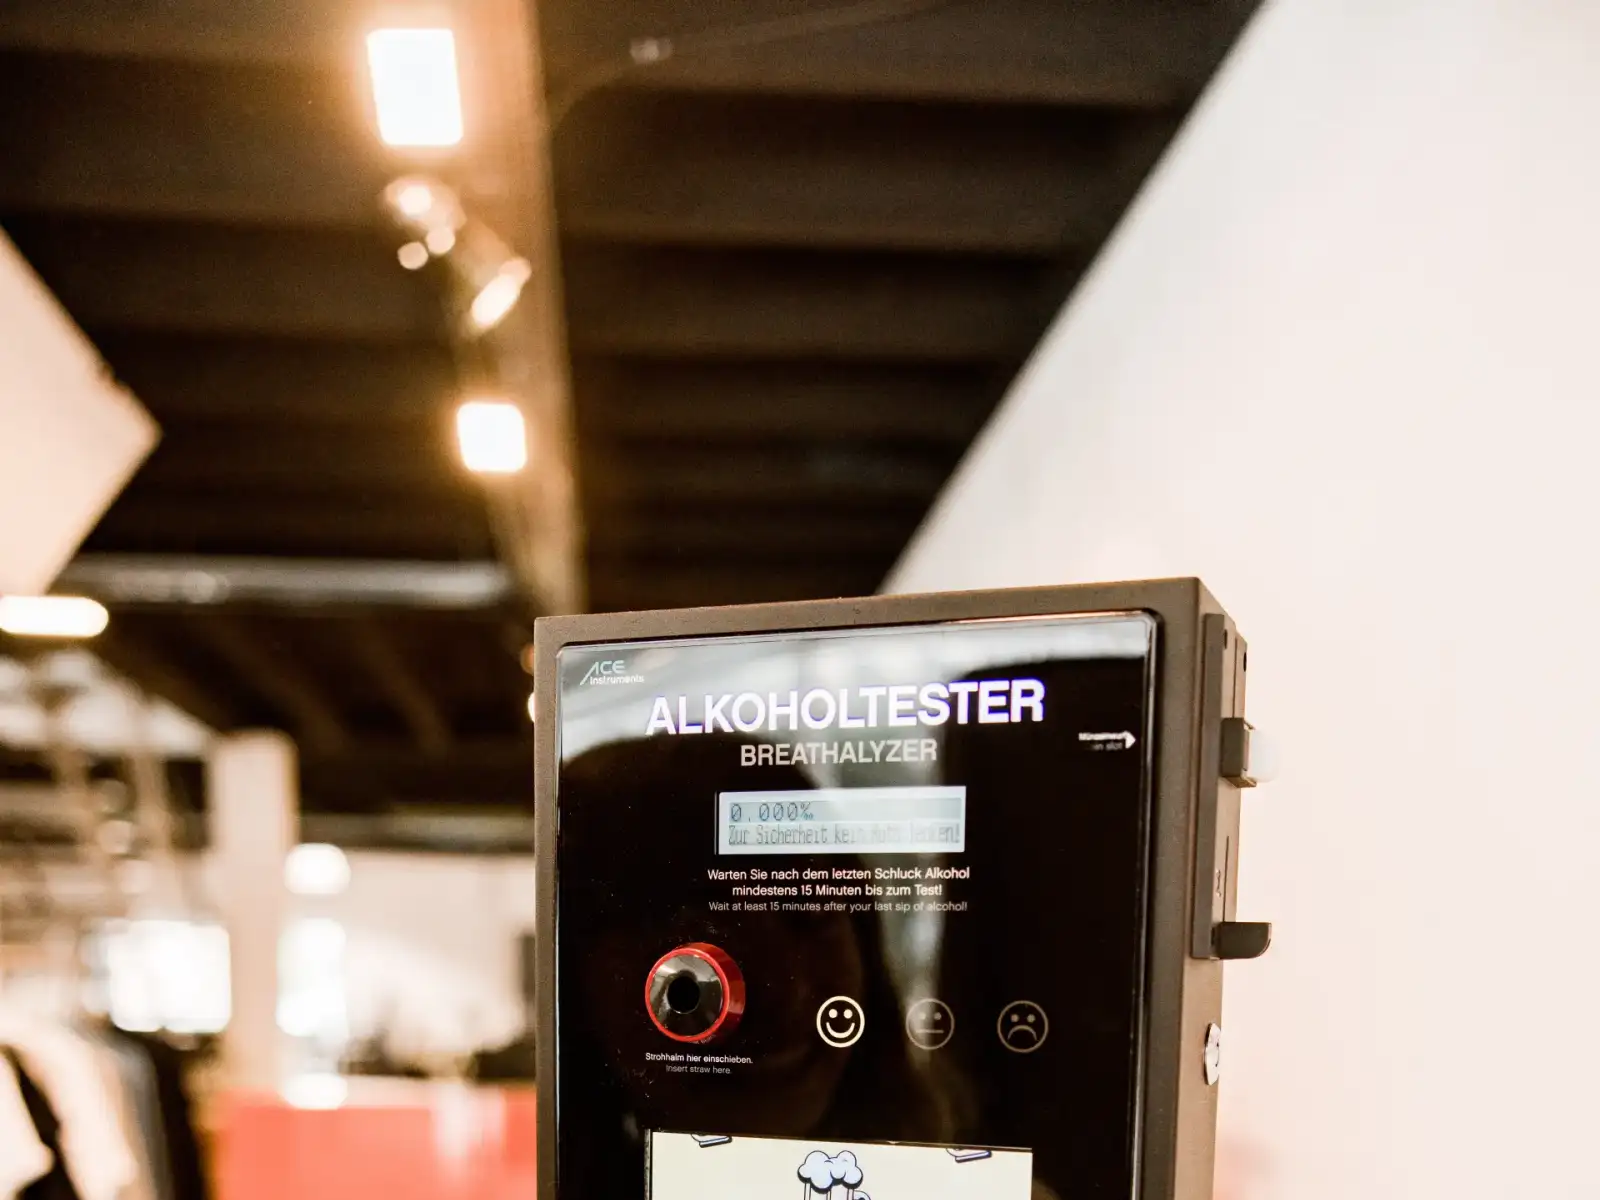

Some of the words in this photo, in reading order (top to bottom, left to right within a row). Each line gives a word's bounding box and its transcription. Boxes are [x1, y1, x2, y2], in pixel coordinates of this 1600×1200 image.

[645, 679, 1046, 736] ALKOHOLTESTER
[740, 738, 937, 767] BREATHALYZER
[728, 824, 750, 845] Zur
[756, 824, 828, 845] Sicherheit
[708, 868, 746, 880] Warten
[750, 868, 768, 880] Sie
[771, 868, 799, 880] nach
[802, 868, 828, 880] dem
[832, 868, 871, 879] letzten
[874, 867, 922, 879] Schluck
[925, 867, 970, 879] Alkohol
[732, 884, 798, 896] mindestens
[801, 885, 812, 896] 15
[816, 884, 861, 896] Minuten
[865, 884, 882, 895] bis
[886, 886, 911, 895] zum
[914, 884, 942, 896] Test!
[709, 902, 729, 911] Wait
[732, 902, 741, 911] at
[744, 901, 767, 911] least
[770, 902, 779, 911] 15
[782, 902, 821, 911] minutes
[824, 902, 846, 911] after
[850, 904, 871, 913] your
[874, 901, 892, 911] last
[895, 902, 910, 913] sip
[913, 901, 923, 911] of
[926, 901, 968, 911] alcohol!
[646, 1052, 684, 1061] Strohhalm
[687, 1054, 701, 1062] hier
[704, 1054, 753, 1063] einschieben.
[666, 1064, 688, 1073] Insert
